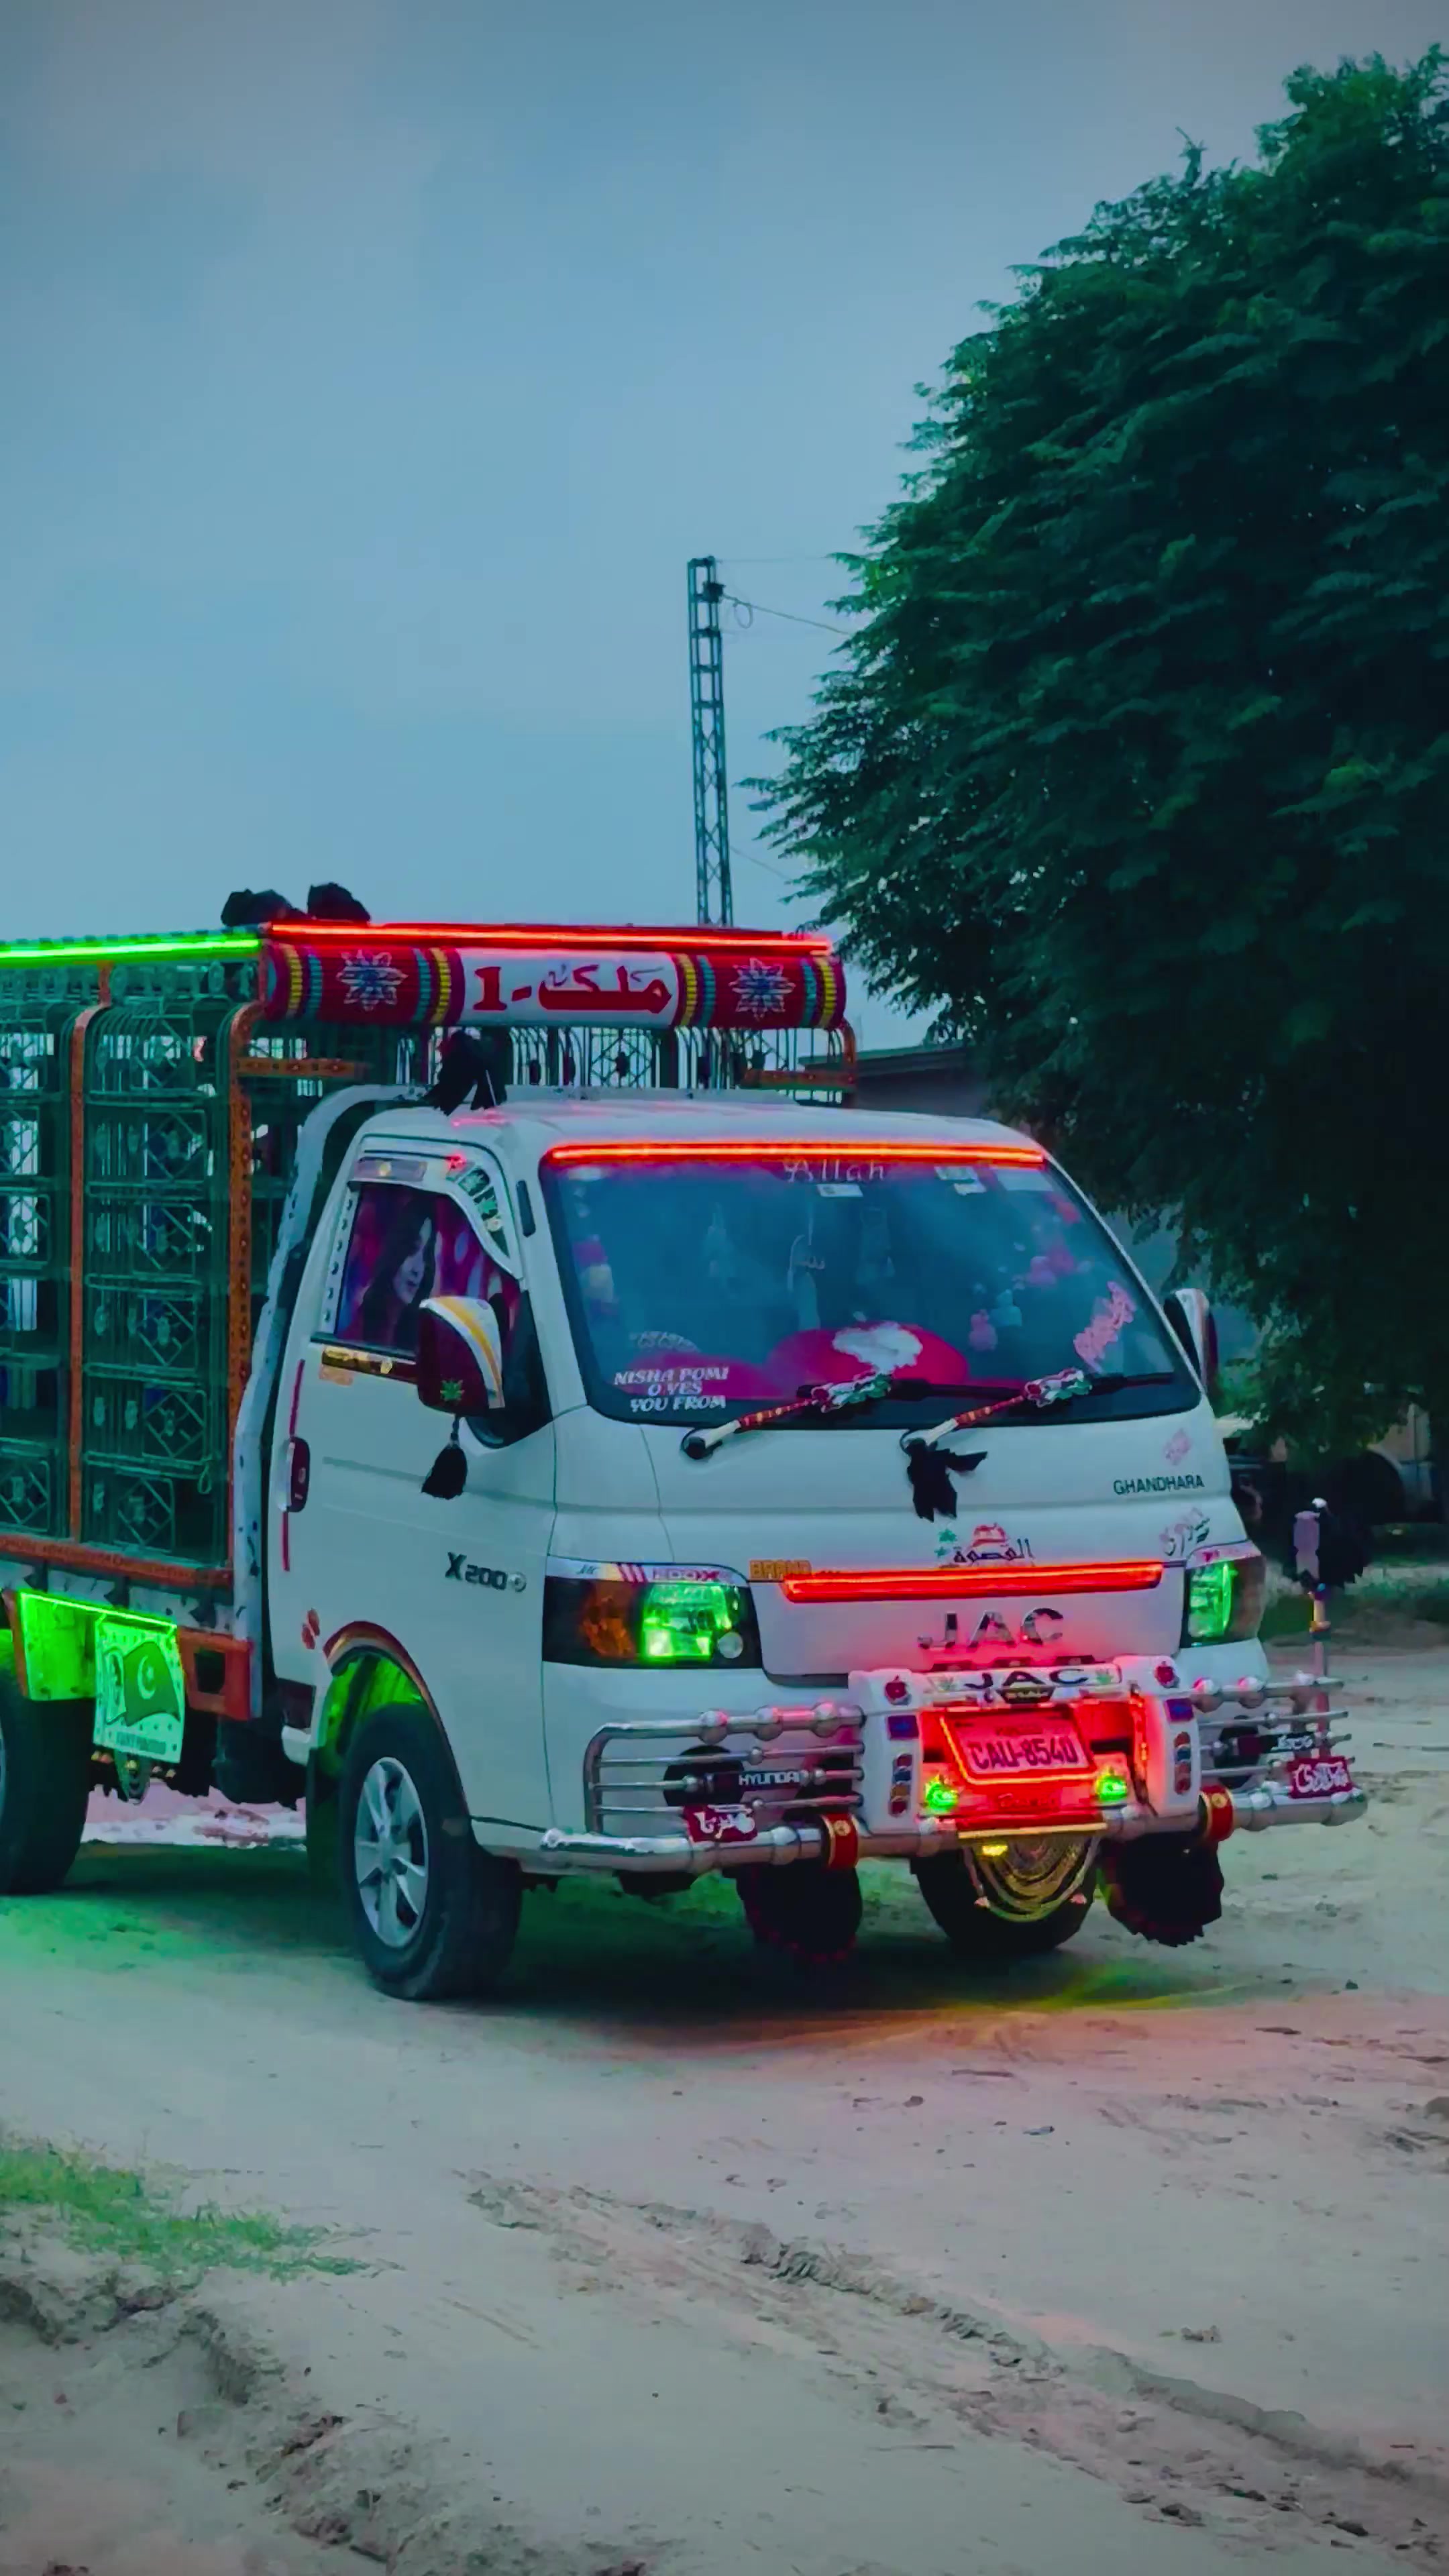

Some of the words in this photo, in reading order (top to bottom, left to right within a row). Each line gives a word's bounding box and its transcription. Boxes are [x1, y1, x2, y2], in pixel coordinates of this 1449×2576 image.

[629, 1397, 669, 1412] YOU
[672, 1395, 727, 1411] FROM
[1113, 1474, 1205, 1496] GHANDHARA
[445, 1552, 508, 1591] X200
[917, 1608, 1064, 1651] JAC
[963, 1668, 1089, 1690] JAC
